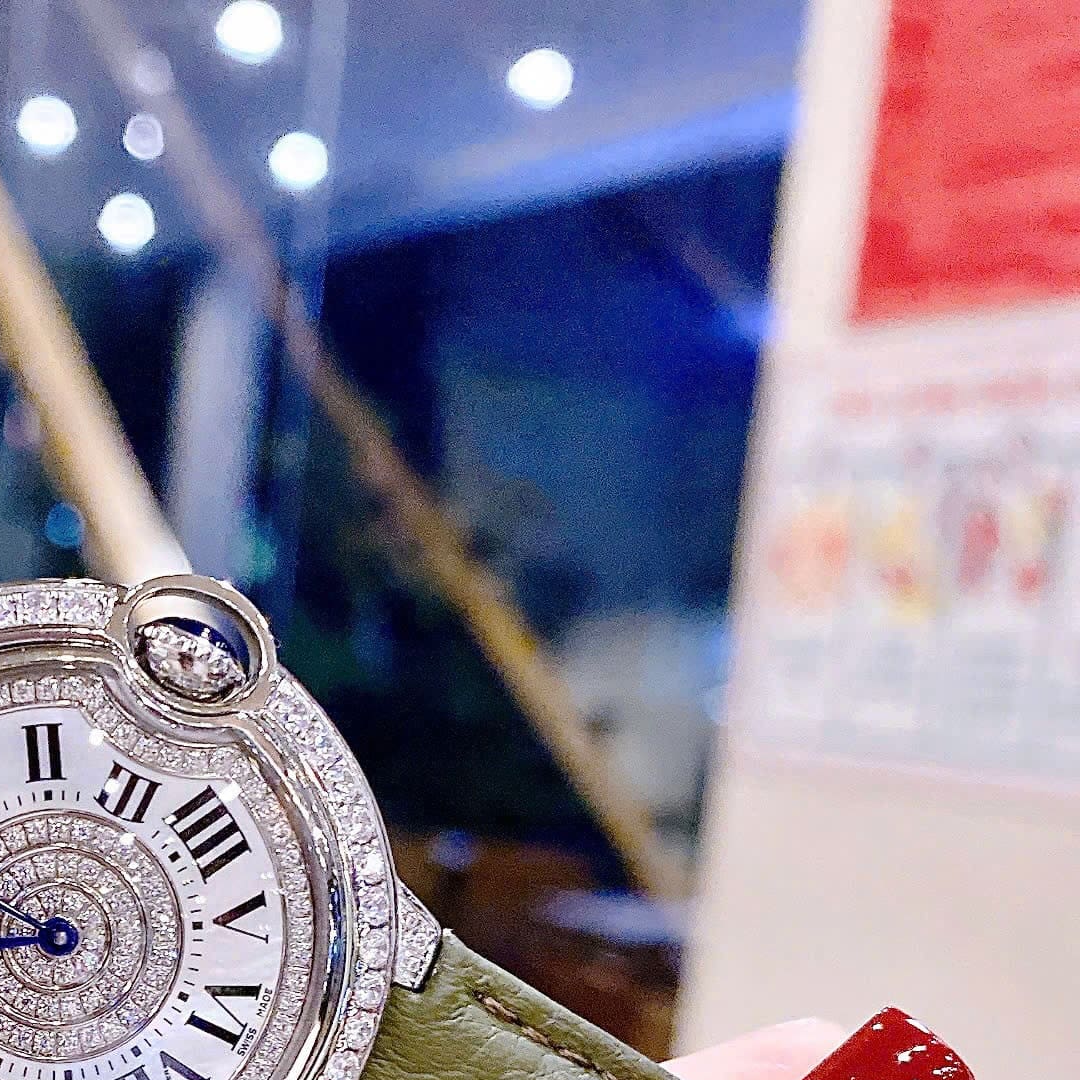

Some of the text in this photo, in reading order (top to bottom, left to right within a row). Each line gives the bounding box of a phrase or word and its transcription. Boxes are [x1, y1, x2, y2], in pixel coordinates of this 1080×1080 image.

[21, 723, 67, 783] II
[93, 760, 162, 823] III
[162, 784, 252, 885] IIII
[212, 890, 269, 944] V
[184, 984, 262, 1051] VI
[237, 1028, 257, 1056] SWISS
